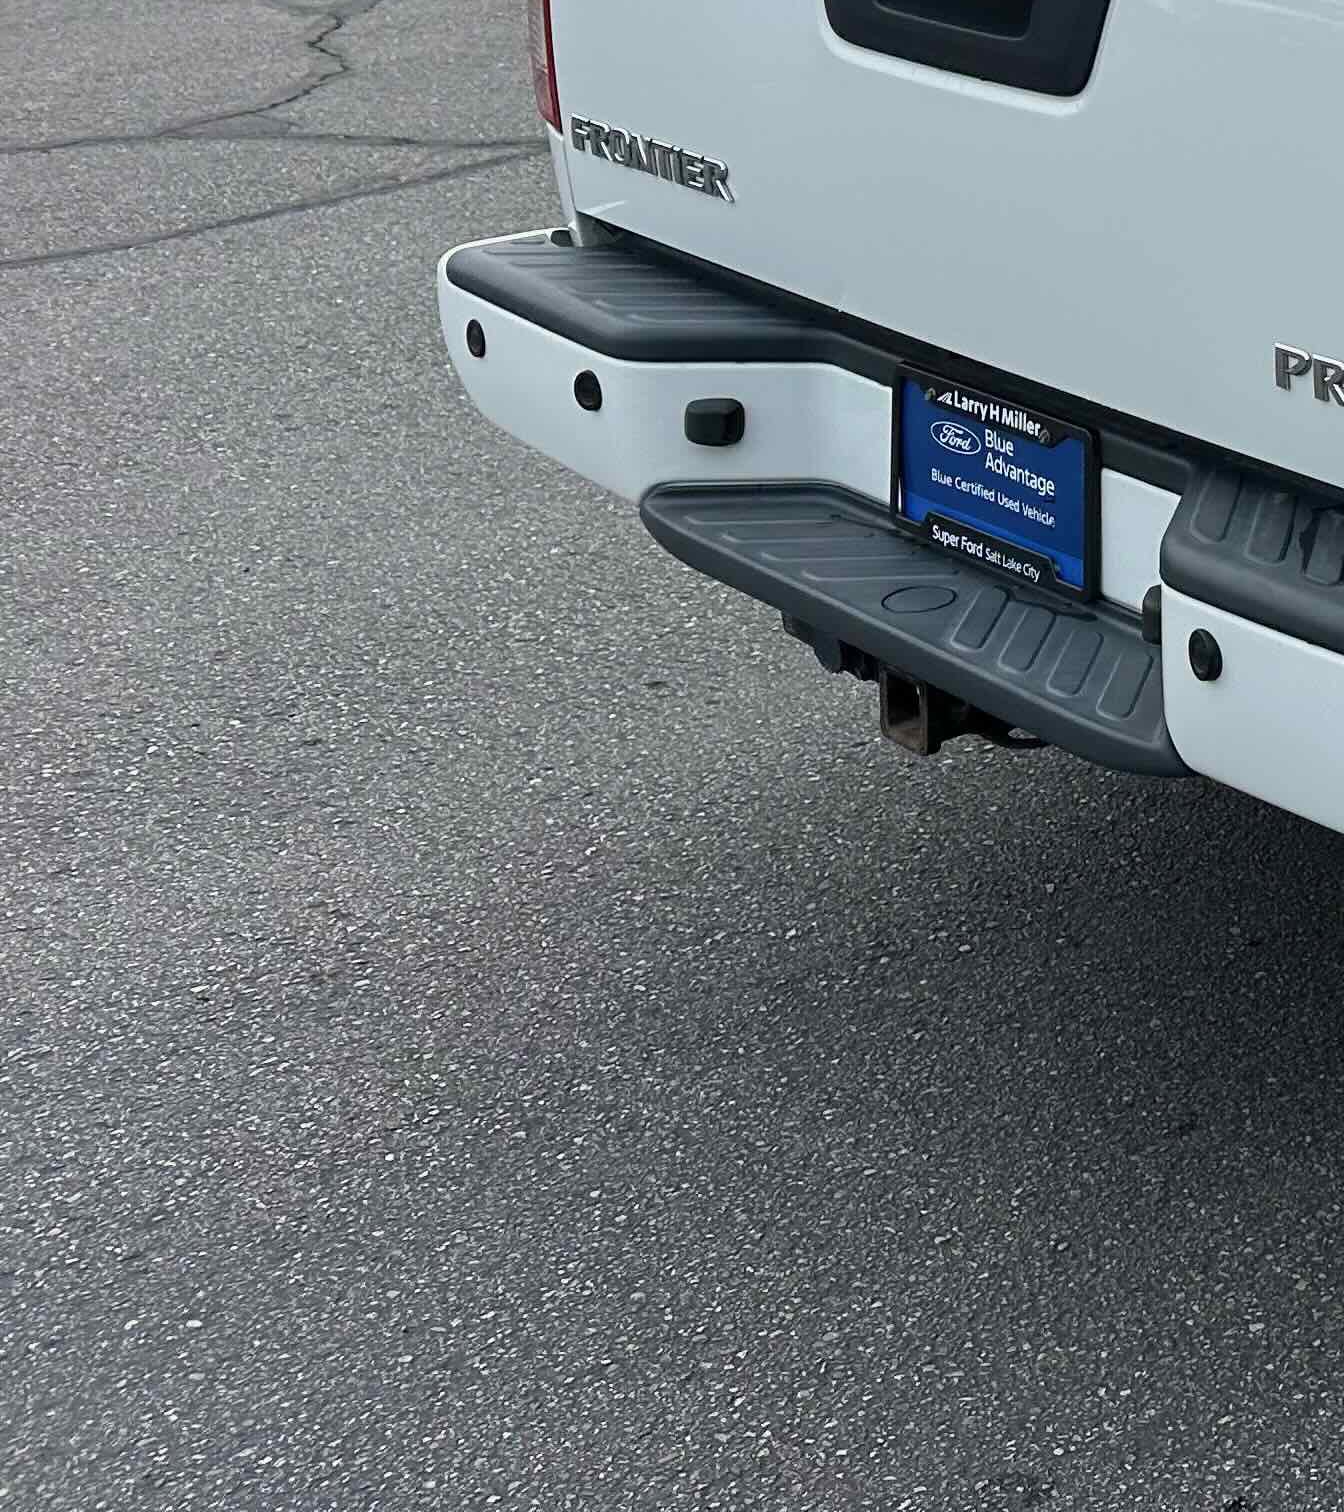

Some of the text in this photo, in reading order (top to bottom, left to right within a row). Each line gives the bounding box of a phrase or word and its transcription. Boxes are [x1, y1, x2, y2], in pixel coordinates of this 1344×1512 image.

[570, 112, 736, 204] FRONTIER
[954, 390, 1042, 437] Larry H Miller
[939, 425, 972, 451] Ford
[985, 428, 1014, 456] Blue
[985, 451, 1056, 496] Advantage
[931, 467, 1056, 528] Blue Certified Used Vehicle
[931, 524, 1041, 583] Super Ford Salt Lake City
